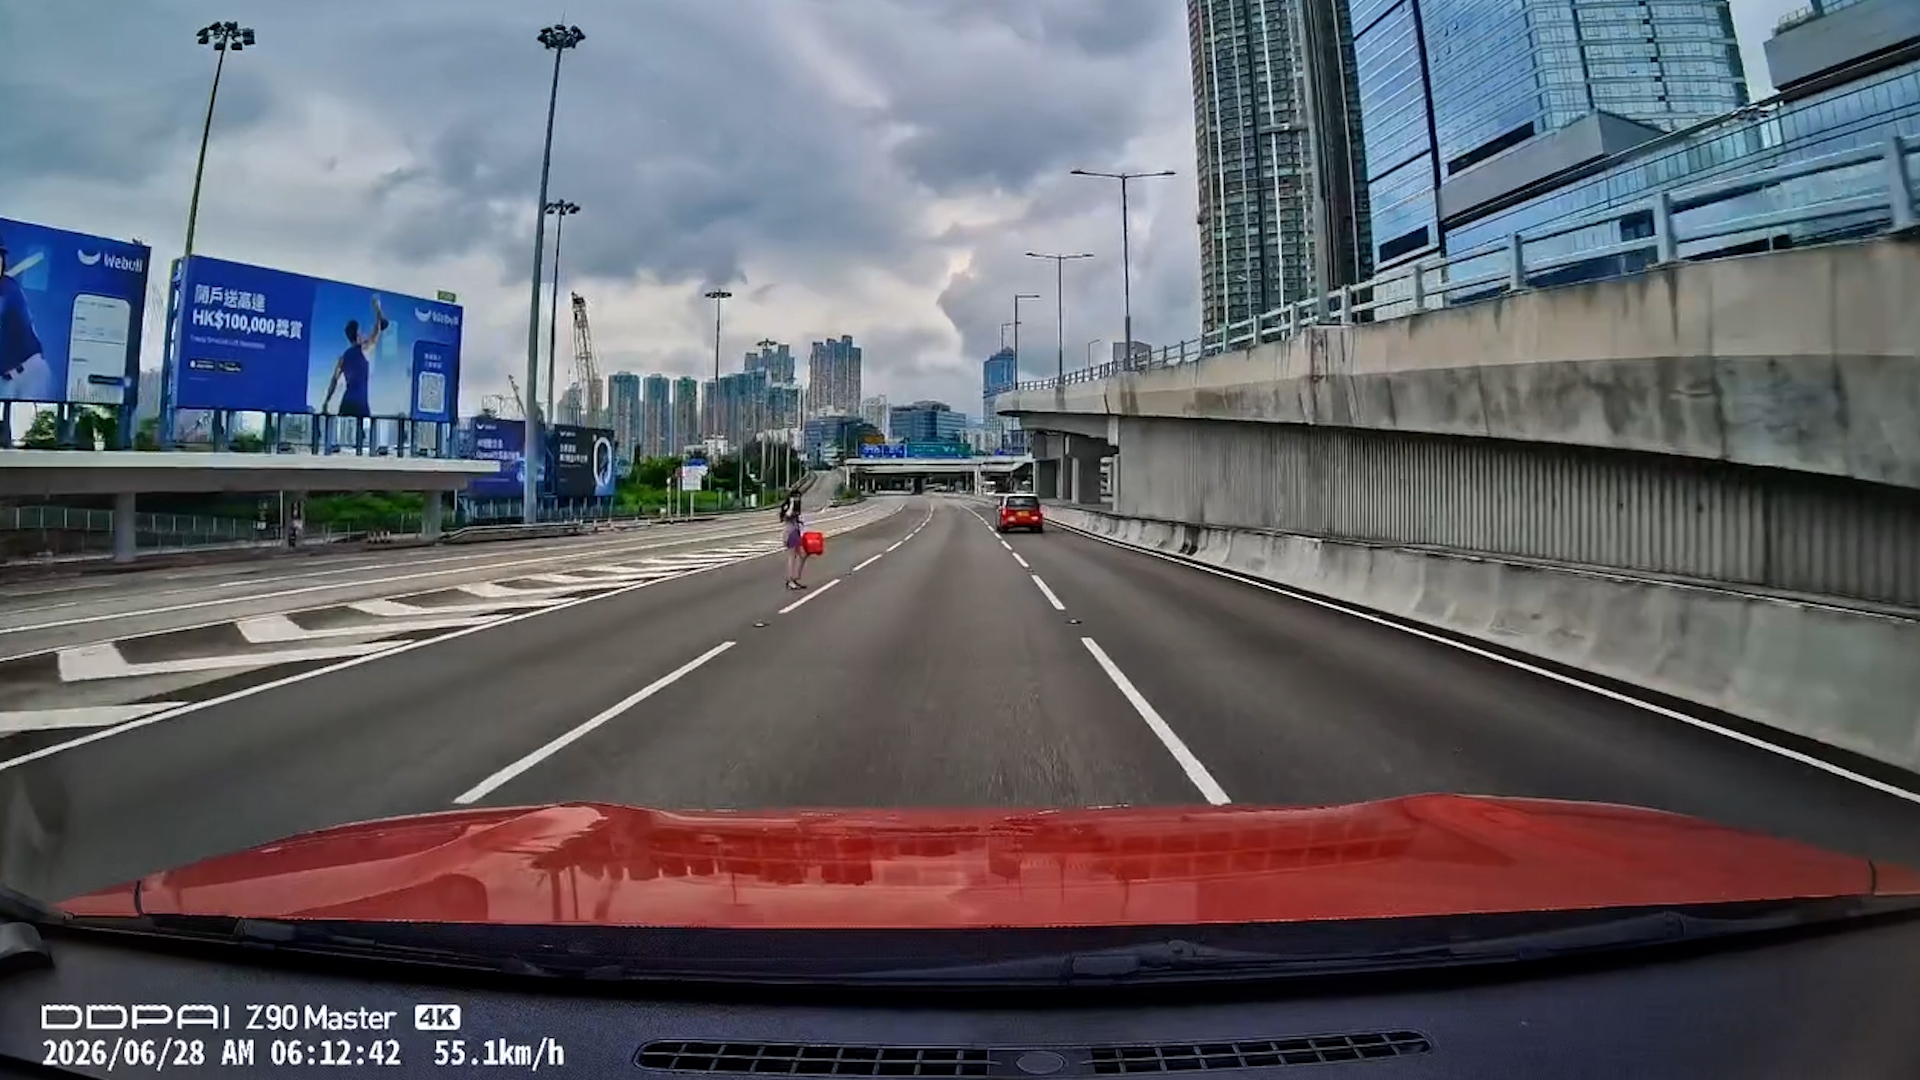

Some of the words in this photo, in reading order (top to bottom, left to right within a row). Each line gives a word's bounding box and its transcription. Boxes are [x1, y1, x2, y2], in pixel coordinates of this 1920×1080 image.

[103, 251, 144, 273] Webull
[194, 283, 266, 313] 開戶送高達
[431, 309, 460, 326] Webull
